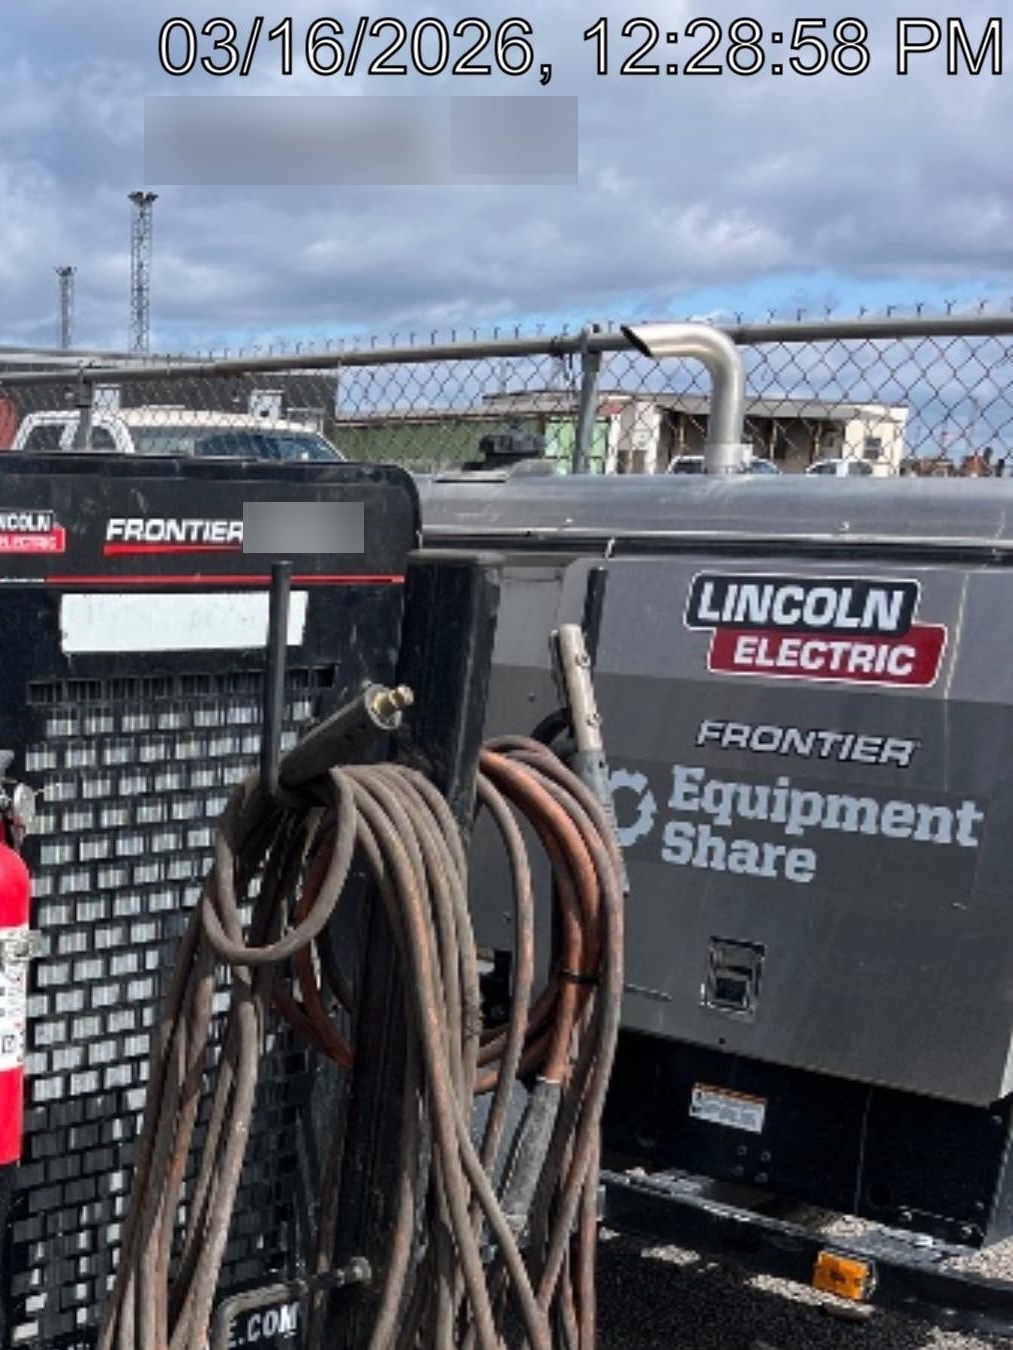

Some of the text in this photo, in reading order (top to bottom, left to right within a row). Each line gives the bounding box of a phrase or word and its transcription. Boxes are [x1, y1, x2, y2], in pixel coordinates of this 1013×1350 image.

[106, 518, 244, 542] FRONTIER
[697, 582, 905, 631] LINCOLN
[733, 635, 916, 676] ELECTRIC
[696, 719, 919, 768] FRONTIER
[667, 764, 984, 847] Equipment
[661, 820, 818, 884] Share
